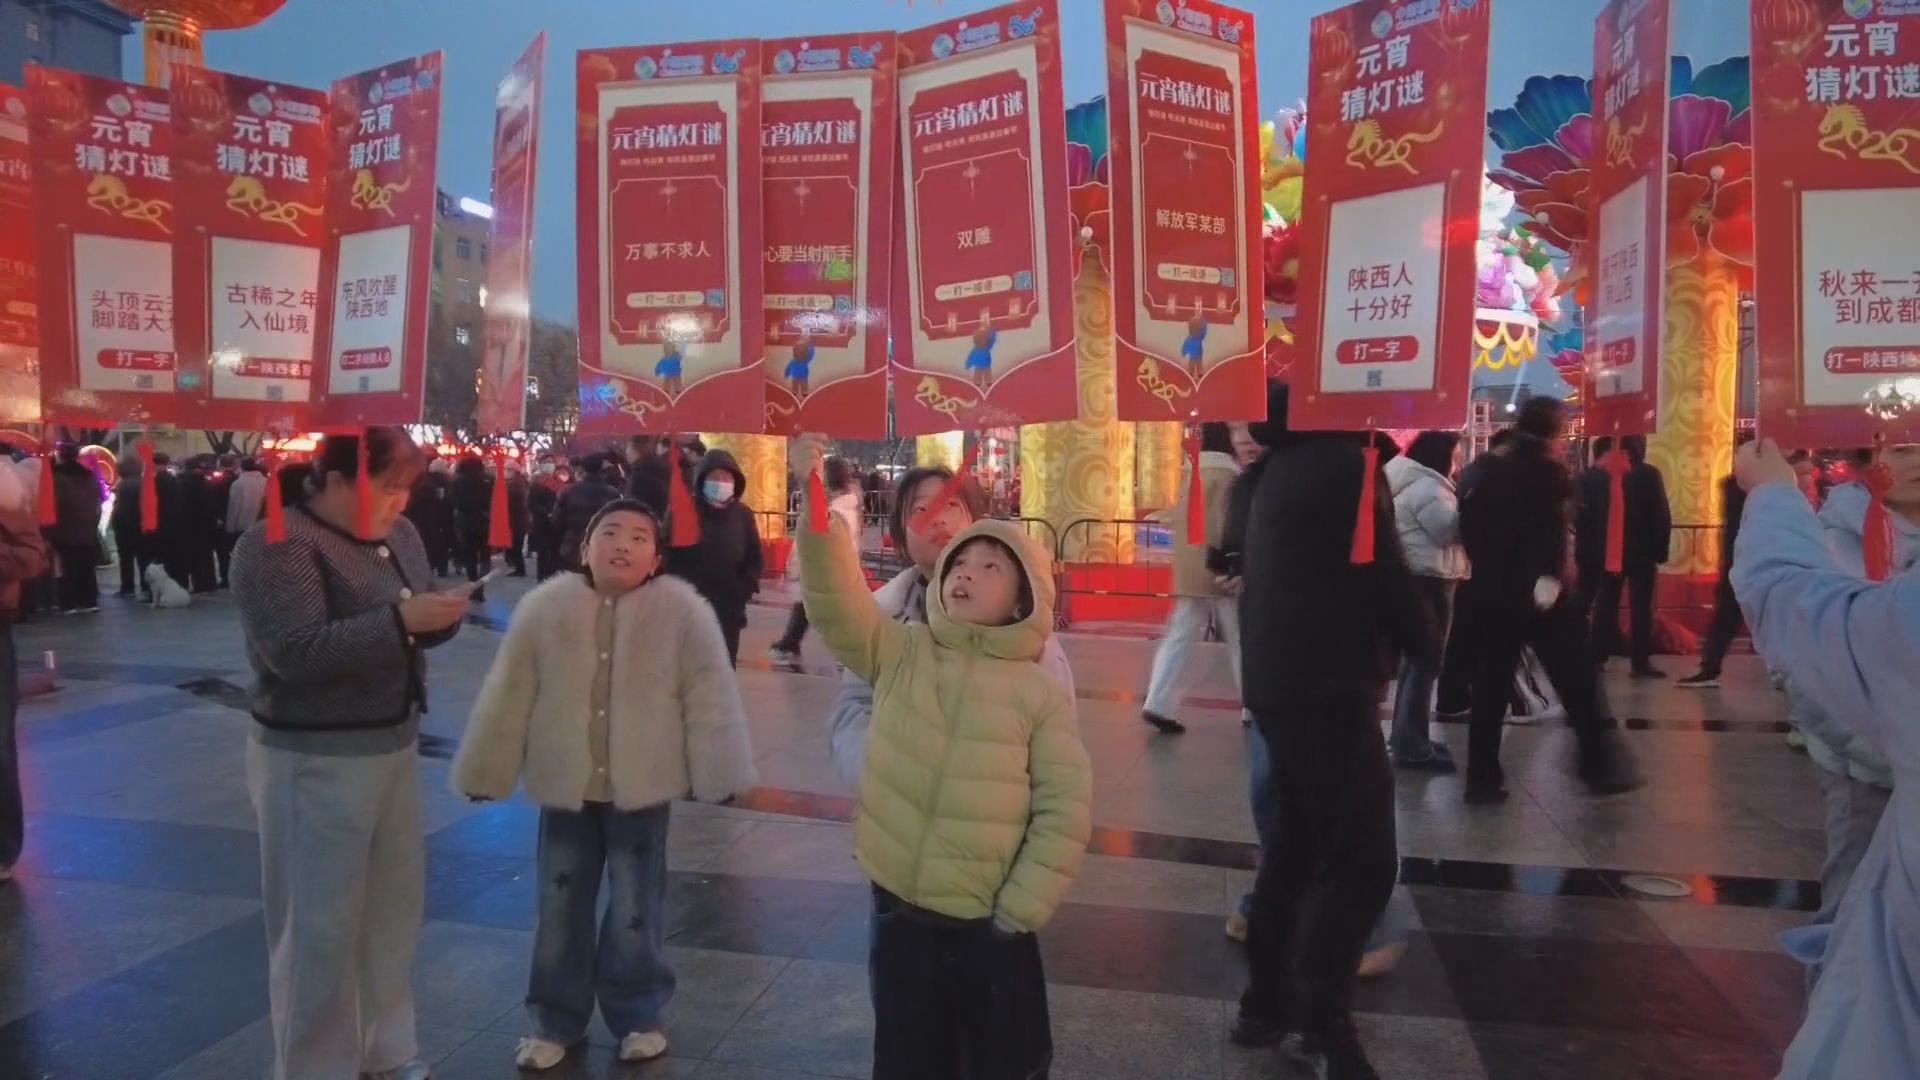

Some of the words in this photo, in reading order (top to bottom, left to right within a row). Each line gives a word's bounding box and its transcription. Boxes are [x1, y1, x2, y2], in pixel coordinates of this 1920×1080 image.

[1824, 20, 1899, 58] 元宵
[1356, 34, 1411, 79] 元宵
[1140, 72, 1233, 115] 元宵猜灯谜
[1341, 70, 1424, 121] 猜灯谜
[1805, 62, 1920, 102] 猜灯谜
[358, 103, 394, 136] 元宵
[914, 90, 1024, 138] 元宵猜灯谜
[91, 115, 152, 147] 元宵
[233, 115, 292, 148] 元宵
[612, 122, 723, 150] 元宵猜灯谜
[75, 143, 172, 181] 猜灯谜
[216, 144, 309, 182] 猜灯谜
[349, 133, 401, 169] 猜灯谜
[1156, 208, 1227, 235] 解放军某部
[625, 241, 711, 261] 万事不求人
[957, 226, 992, 249] 双雕
[342, 274, 397, 301] 东风吹醒
[1348, 261, 1414, 293] 陕西人
[226, 283, 319, 309] 古稀之年
[345, 298, 388, 320] 陕西地
[1347, 294, 1412, 323] 十分好
[1835, 297, 1920, 324] 到成都
[239, 310, 310, 333] 入仙境
[117, 351, 170, 367] 打一字
[1354, 341, 1400, 360] 打一字
[1826, 352, 1920, 369] 打一陕西地
